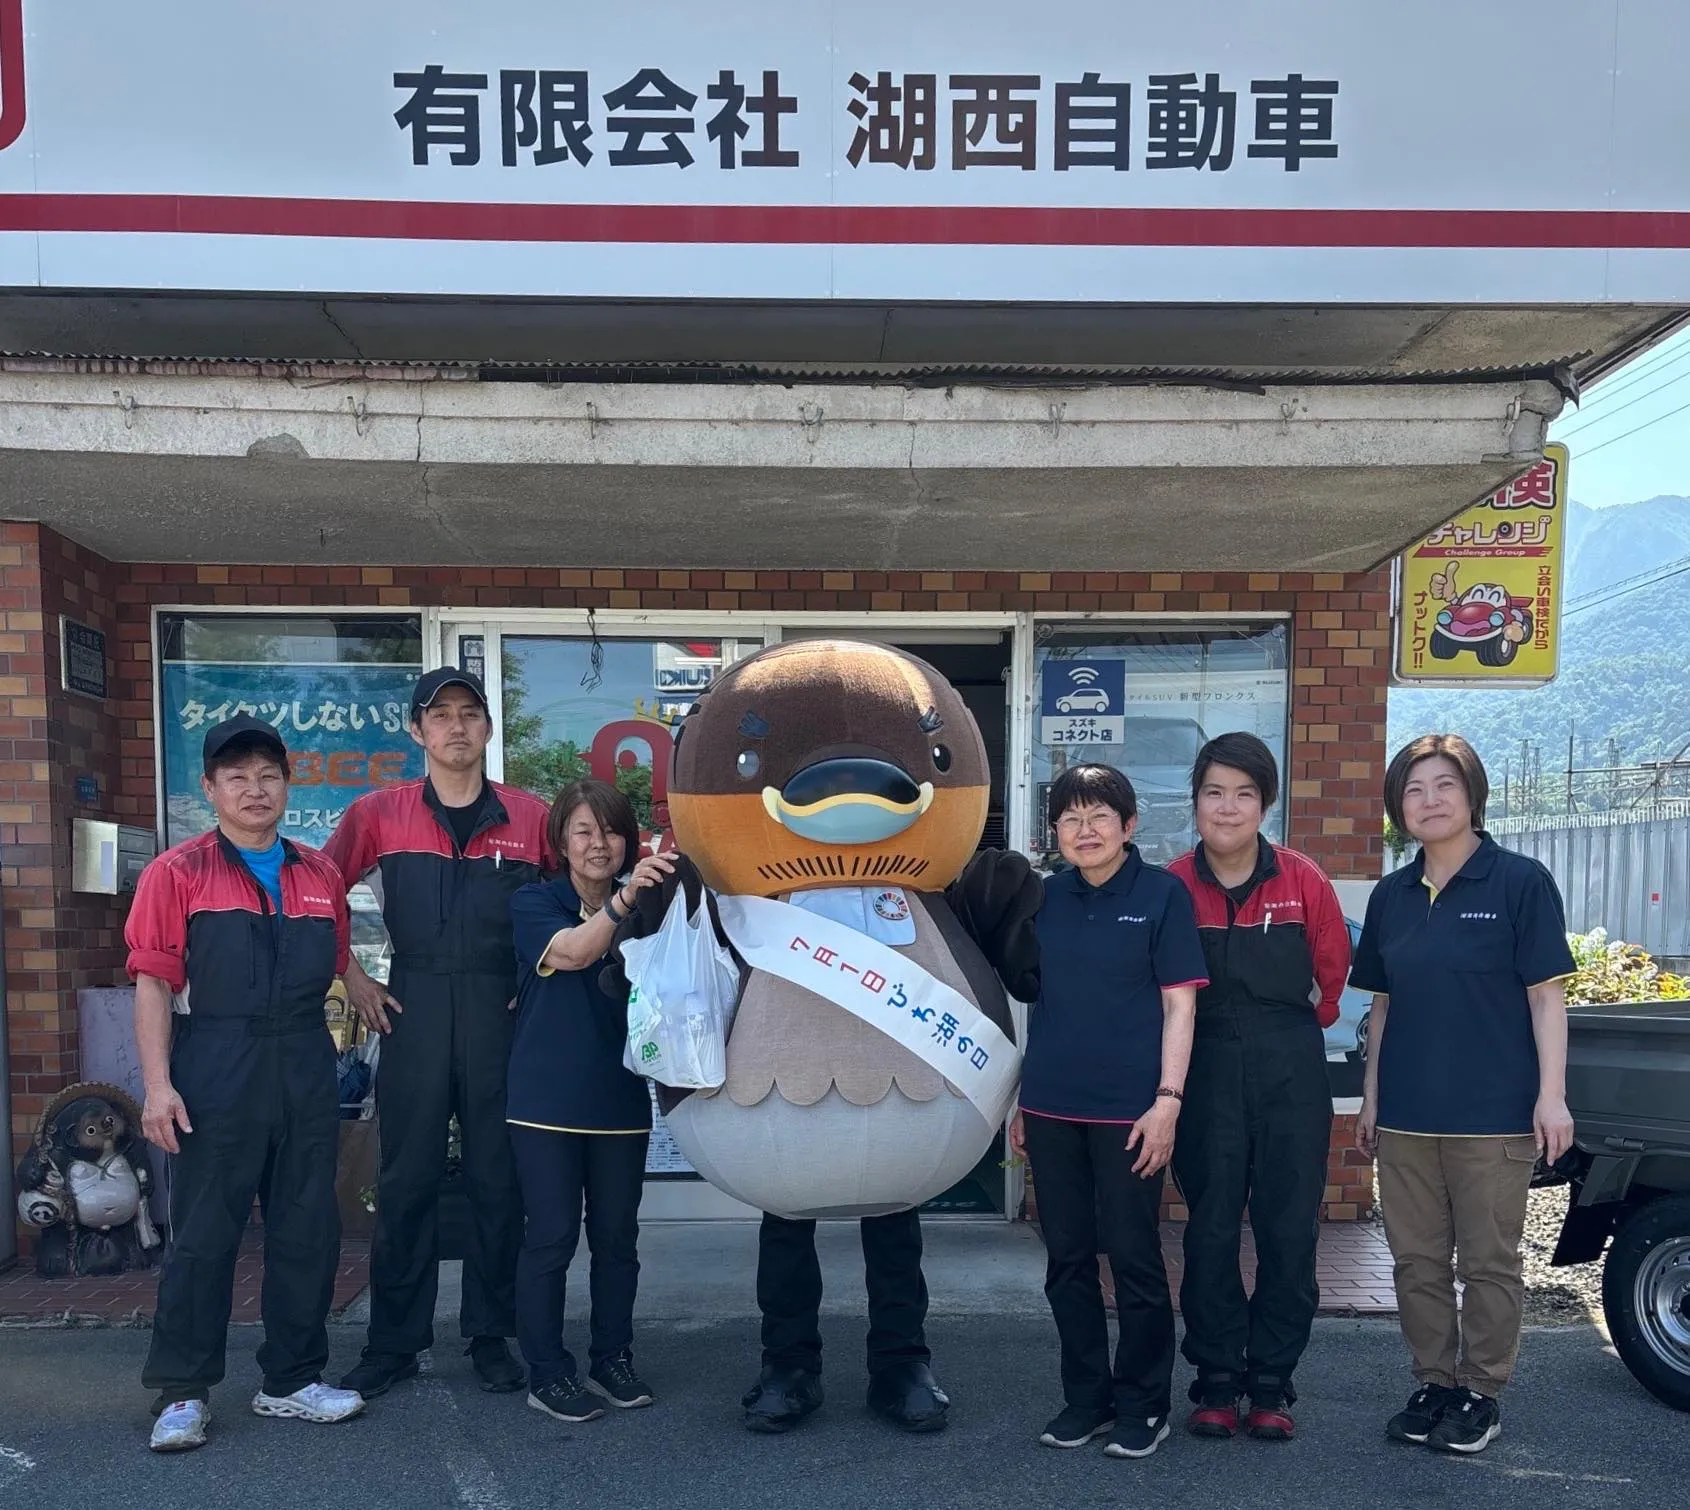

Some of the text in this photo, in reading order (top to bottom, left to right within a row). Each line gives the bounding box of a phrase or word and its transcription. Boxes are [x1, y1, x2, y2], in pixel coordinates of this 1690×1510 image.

[392, 65, 1339, 172] 有限会社 湖西自動車
[1427, 516, 1552, 545] チャレンジ
[1445, 549, 1527, 557] Challenge Group
[1534, 564, 1552, 650] 立会い車検だから
[1412, 590, 1429, 669] ナットク!!
[179, 700, 412, 733] タイクツしないSU
[1068, 718, 1097, 728] スズキ
[1052, 728, 1113, 742] コネクト店
[286, 751, 406, 786] BEE
